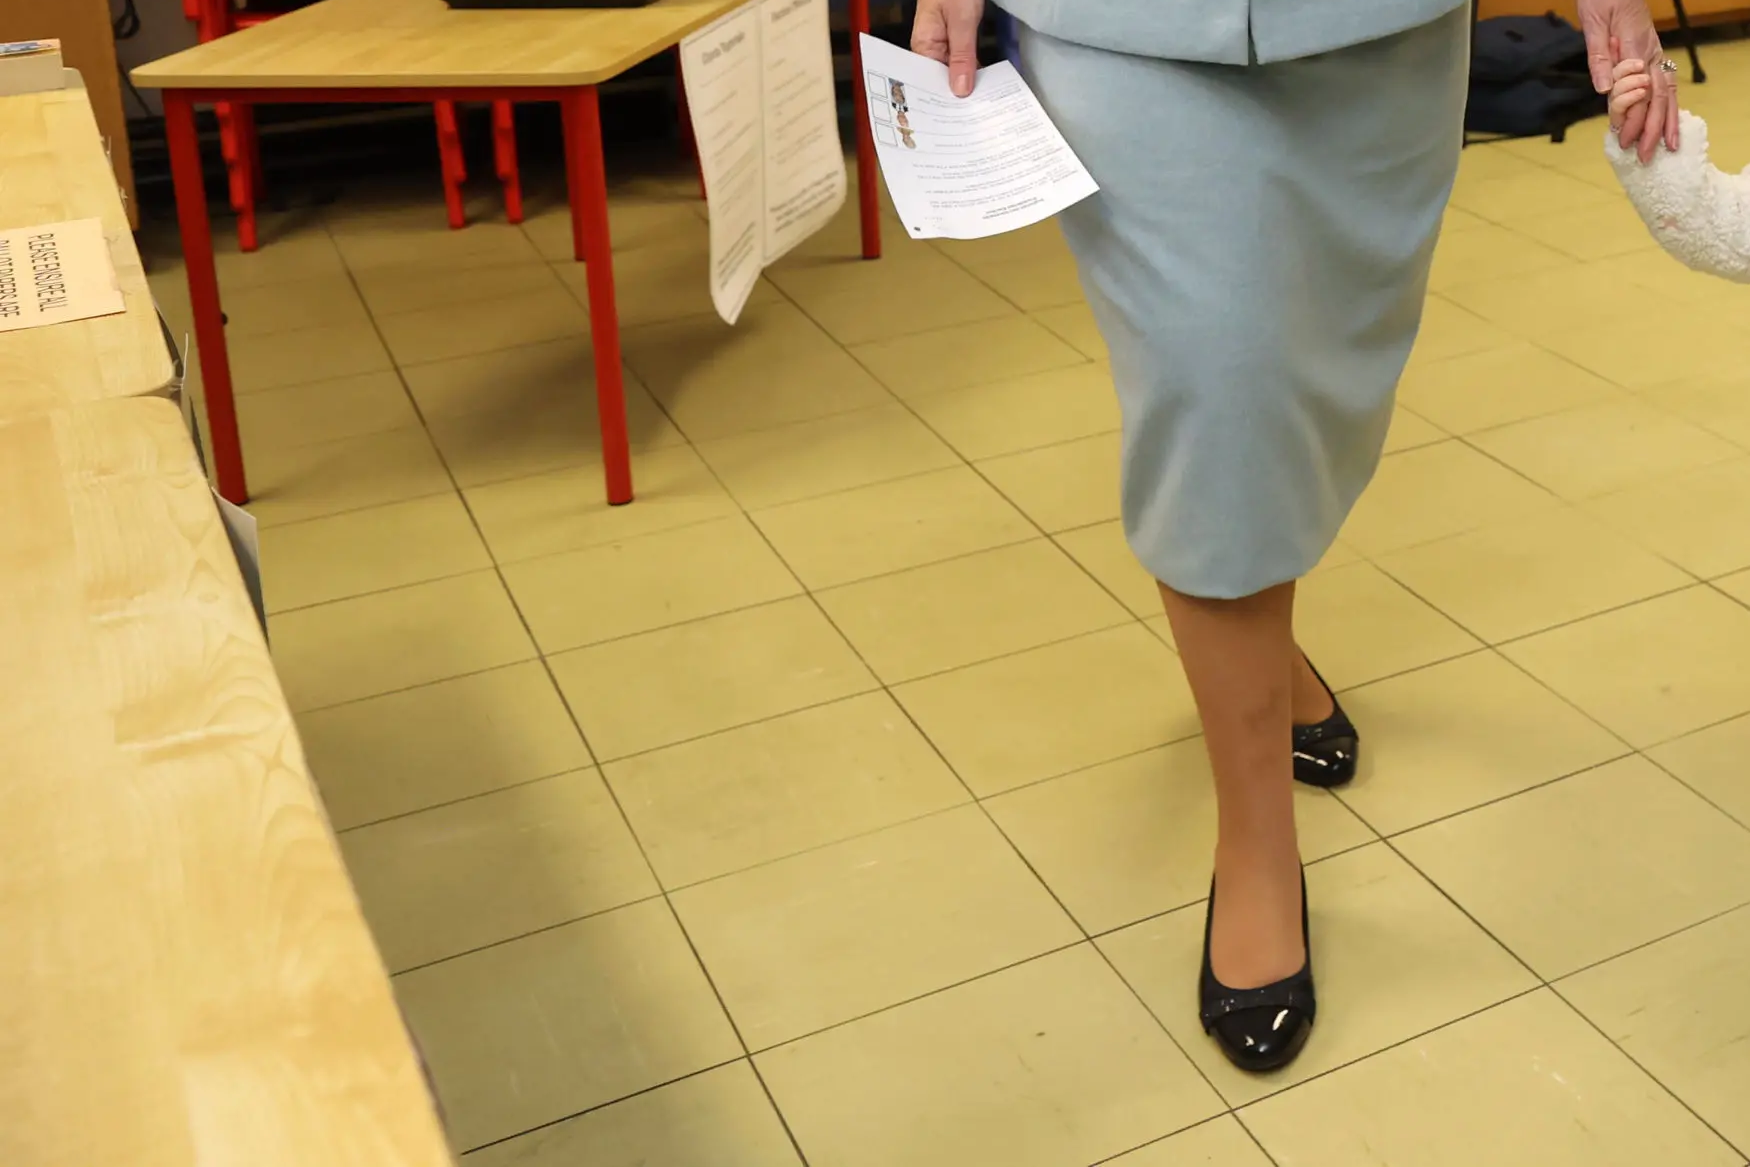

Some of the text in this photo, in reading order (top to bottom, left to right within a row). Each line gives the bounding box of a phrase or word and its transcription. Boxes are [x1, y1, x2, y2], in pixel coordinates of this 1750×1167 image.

[28, 233, 68, 312] PLEASE ENSURE ALL
